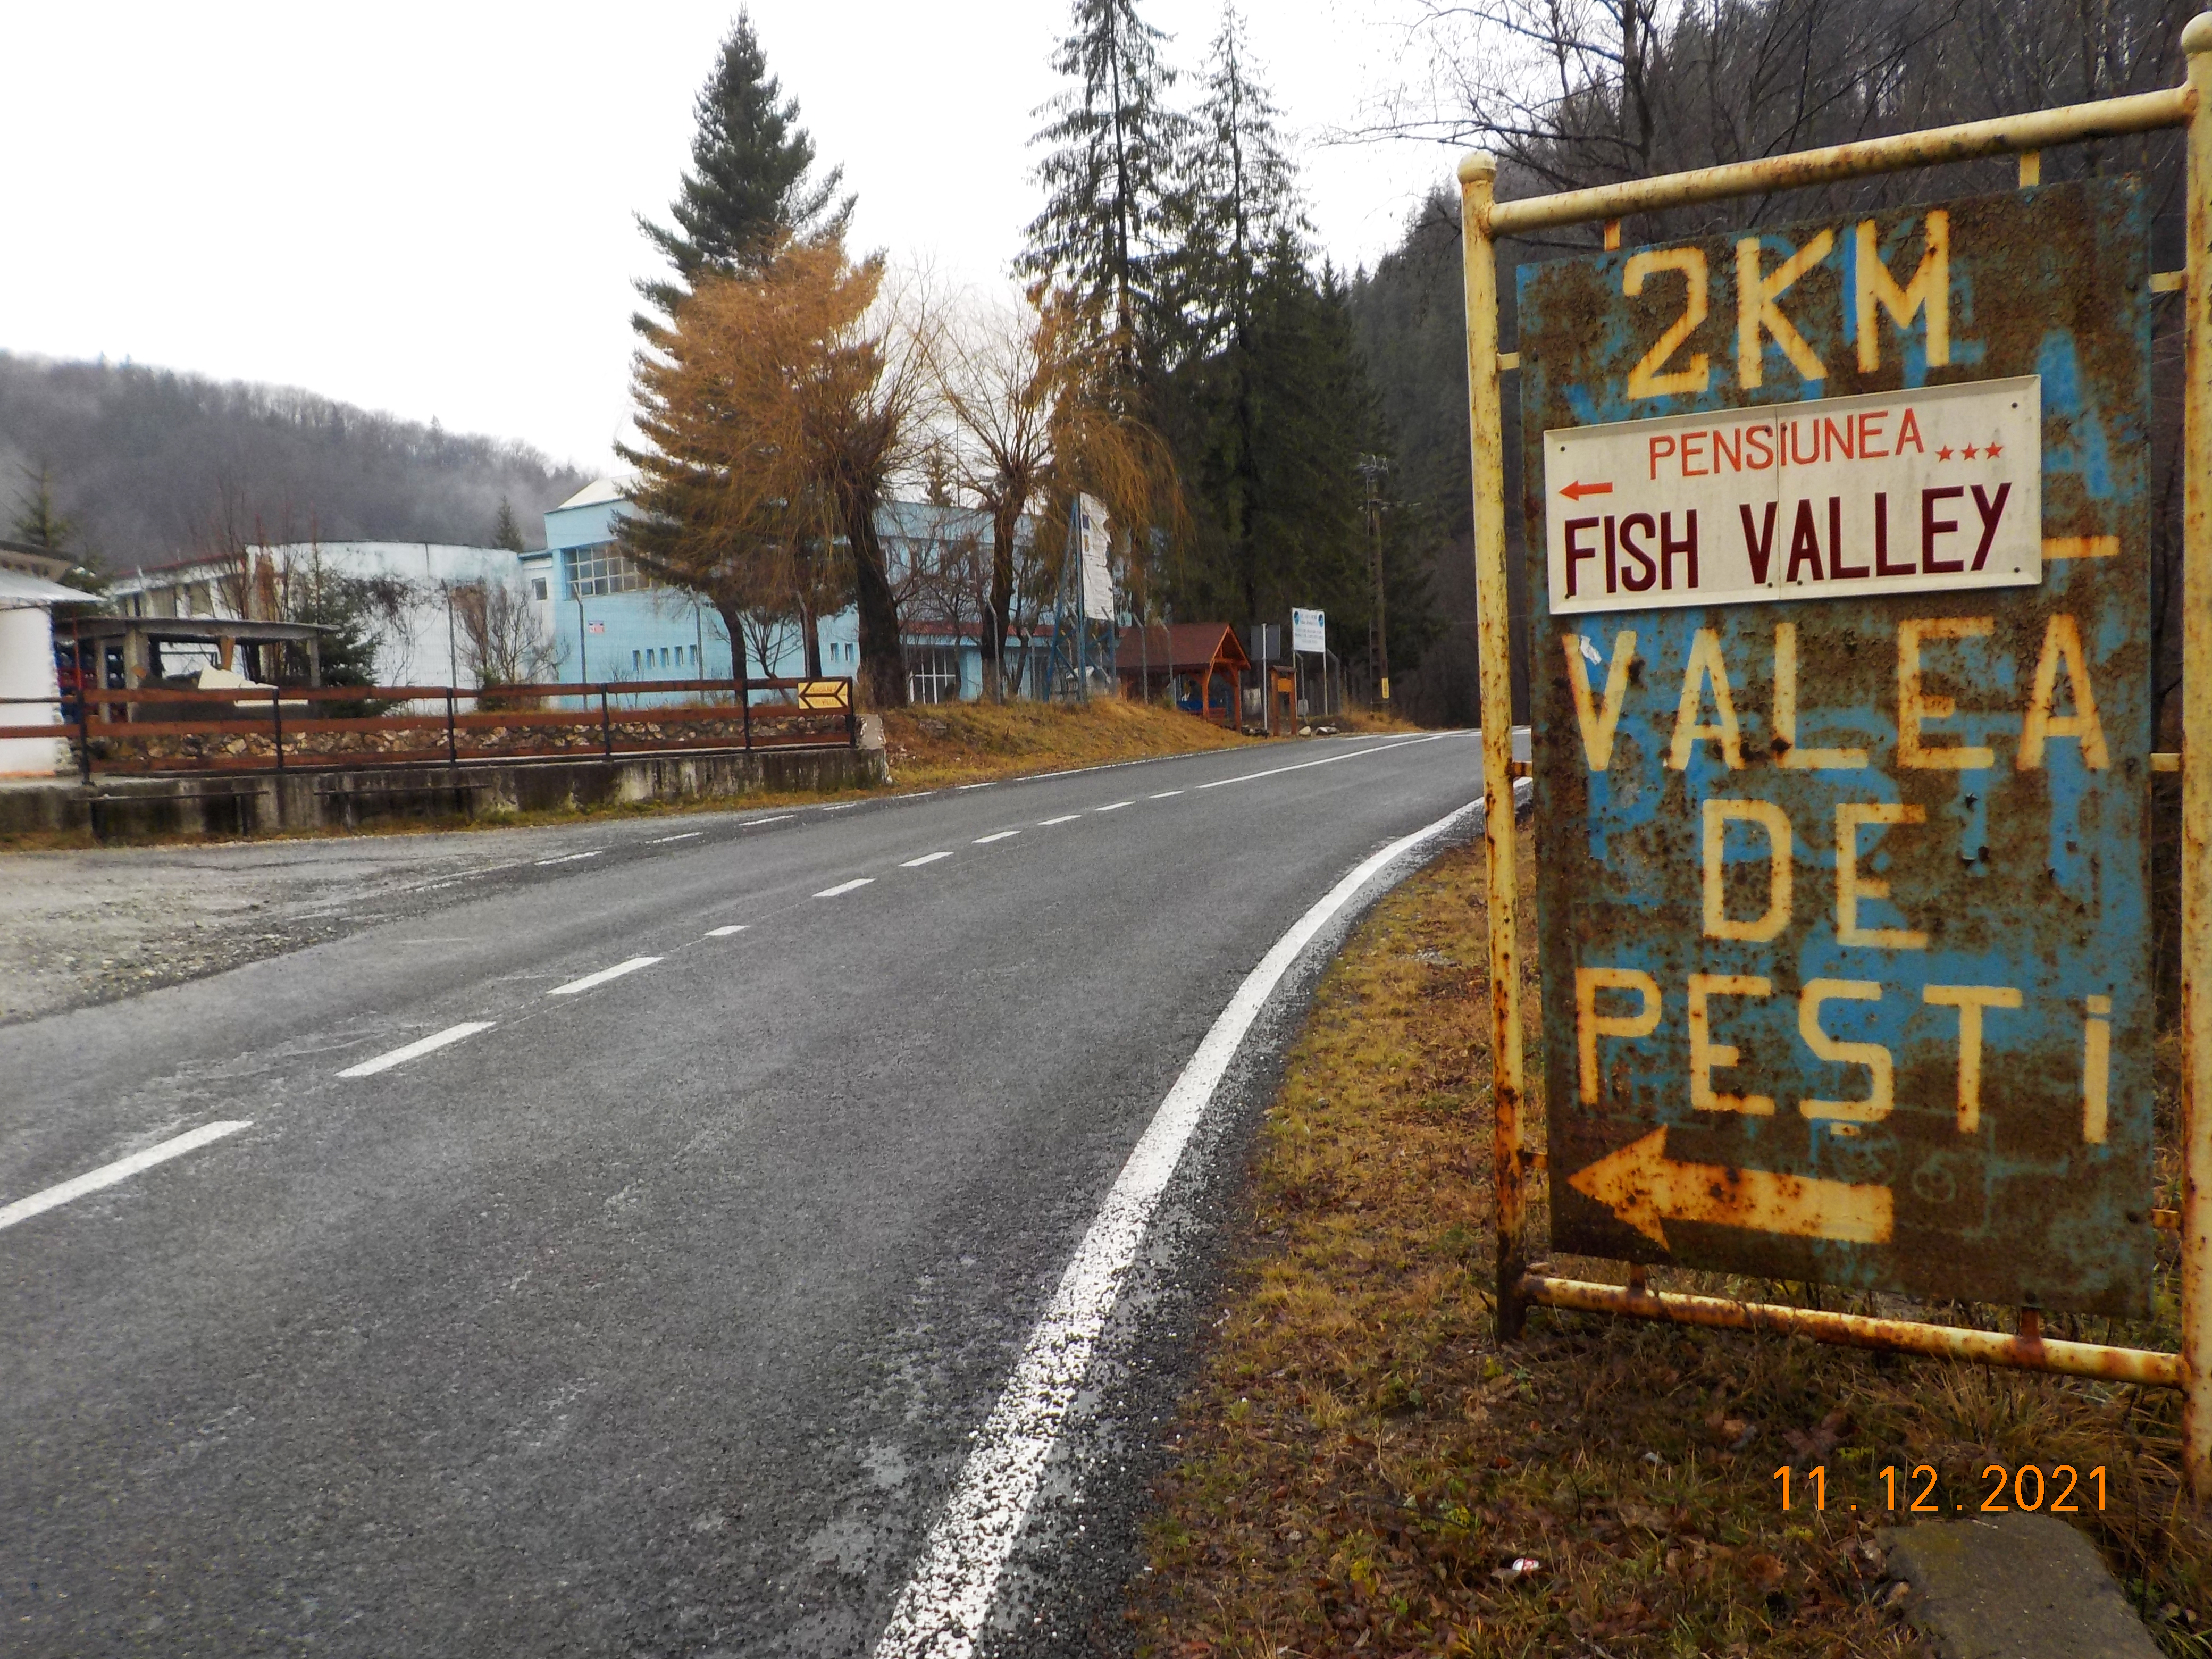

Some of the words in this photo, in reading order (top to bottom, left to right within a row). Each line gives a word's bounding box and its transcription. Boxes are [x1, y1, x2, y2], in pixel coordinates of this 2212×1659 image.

[1649, 408, 1925, 480] PENSIUNEA
[1564, 509, 1698, 598] FISH
[1739, 482, 2012, 586] VALLEY
[1562, 614, 2111, 771] VALEA
[1702, 799, 1929, 949] DE
